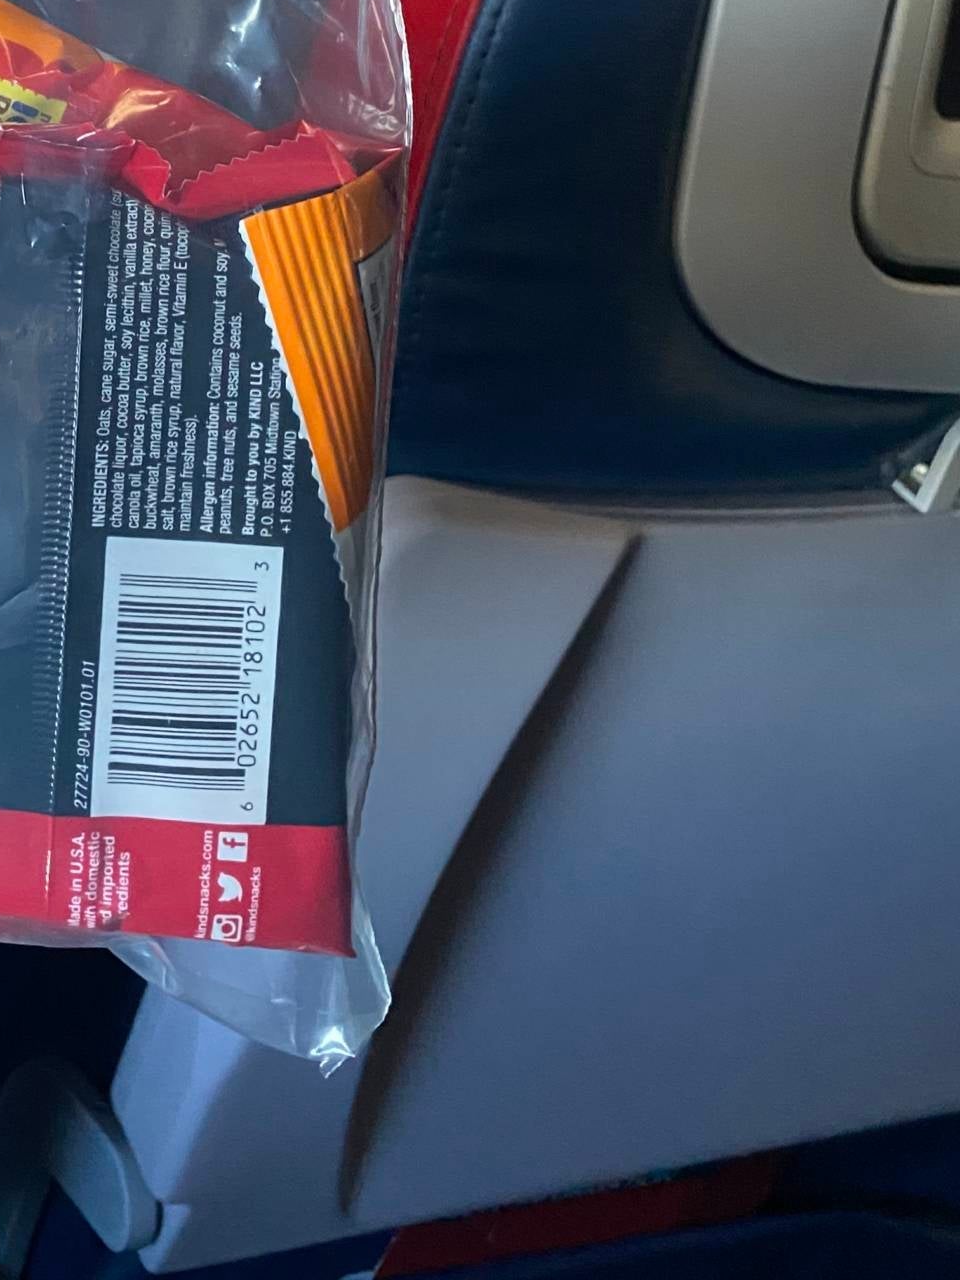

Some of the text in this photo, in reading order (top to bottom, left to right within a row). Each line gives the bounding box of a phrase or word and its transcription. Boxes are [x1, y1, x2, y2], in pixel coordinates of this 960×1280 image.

[140, 238, 156, 275] honey,
[138, 278, 153, 312] millet,
[213, 275, 227, 296] and
[136, 317, 152, 341] rice,
[213, 300, 225, 345] coconut
[91, 210, 121, 526] INGREDIENTS: Oats, cane sugar, semi-sweet chocolate
[109, 243, 136, 527] chocolate liquor, cocoa butter, soy lecithin, vanilla
[134, 345, 148, 380] brown
[143, 242, 172, 529] buckwheat, amaranth, molasses, brown rice flour,
[206, 348, 223, 398] Contains
[133, 385, 148, 420] syrup,
[160, 261, 187, 530] salt, brown rice syrup, natural flavor, Vitamin E
[130, 424, 145, 465] tapioca
[202, 402, 219, 477] information:
[218, 312, 241, 534] peanuts, tree nuts, and sesame seeds.
[242, 361, 263, 535] Brought to you by KIND LLC
[264, 402, 280, 453] Midtown
[128, 470, 143, 486] oil,
[178, 414, 199, 531] maintain freshness).
[263, 457, 277, 479] 705
[279, 430, 296, 534] +1 855.884.KIND
[127, 490, 140, 528] canola
[200, 481, 217, 532] Allergen
[261, 484, 275, 508] BOX
[260, 513, 273, 536] P.O.
[237, 560, 268, 811] 6 02652 18102 3
[73, 660, 95, 808] 27724-90-W0101.01
[69, 831, 85, 873] U.S.A.
[84, 831, 99, 900] domestic
[98, 835, 116, 905] imported
[68, 878, 82, 891] in
